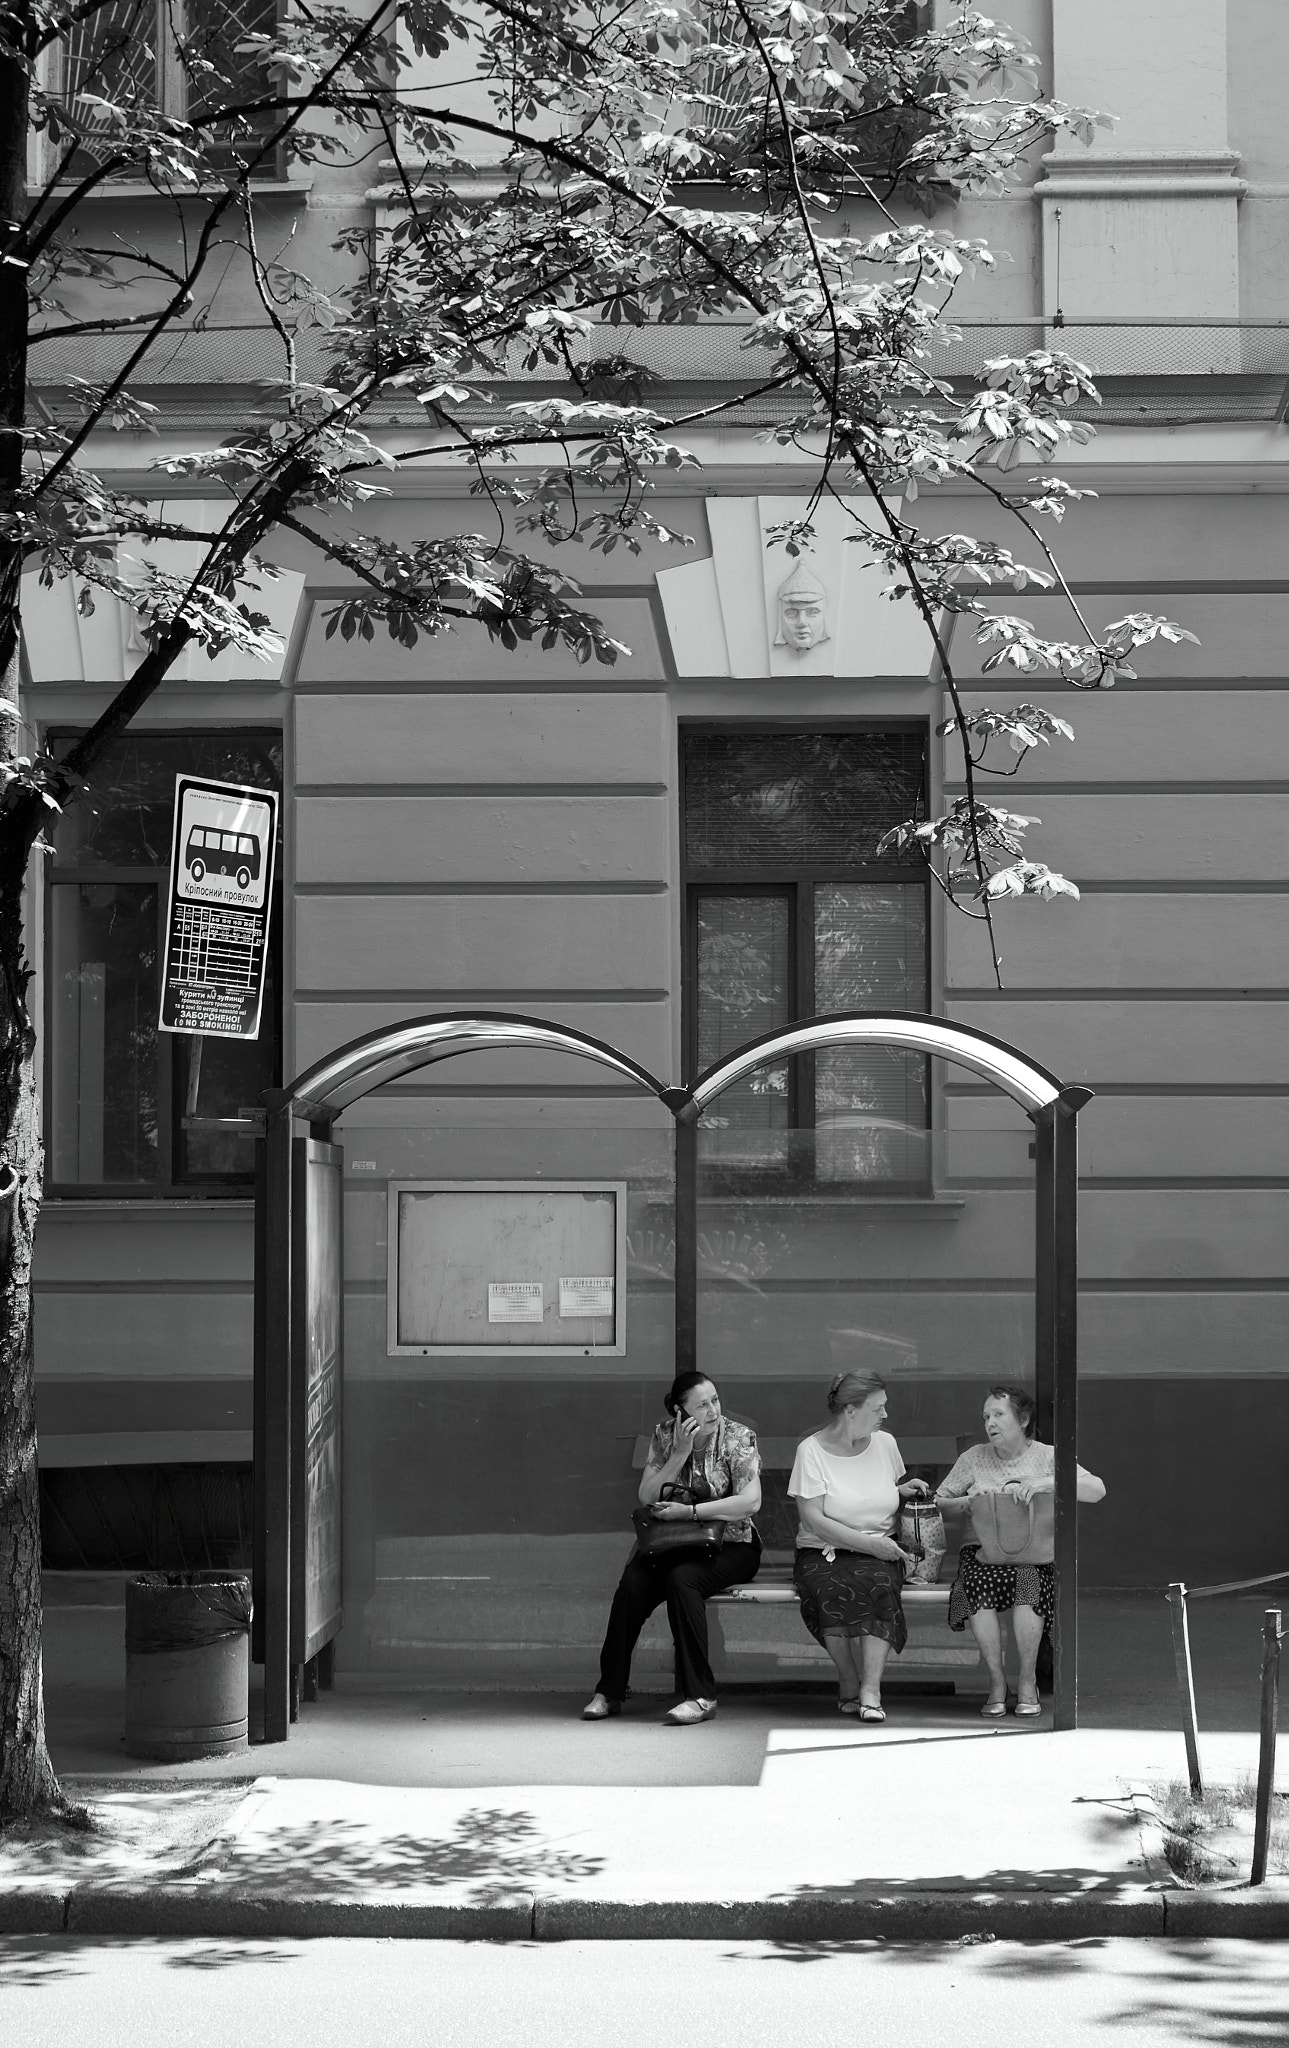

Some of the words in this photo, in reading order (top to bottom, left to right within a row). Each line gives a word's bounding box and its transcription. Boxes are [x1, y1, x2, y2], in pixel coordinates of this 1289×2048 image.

[185, 882, 222, 898] Кріпосний
[224, 890, 259, 904] провулок
[180, 990, 205, 999] Курити
[217, 994, 244, 1003] зупинці
[214, 1001, 241, 1010] транспорту
[180, 1010, 240, 1024] ЗАБОРОНЕНО!
[185, 1018, 197, 1027] NO
